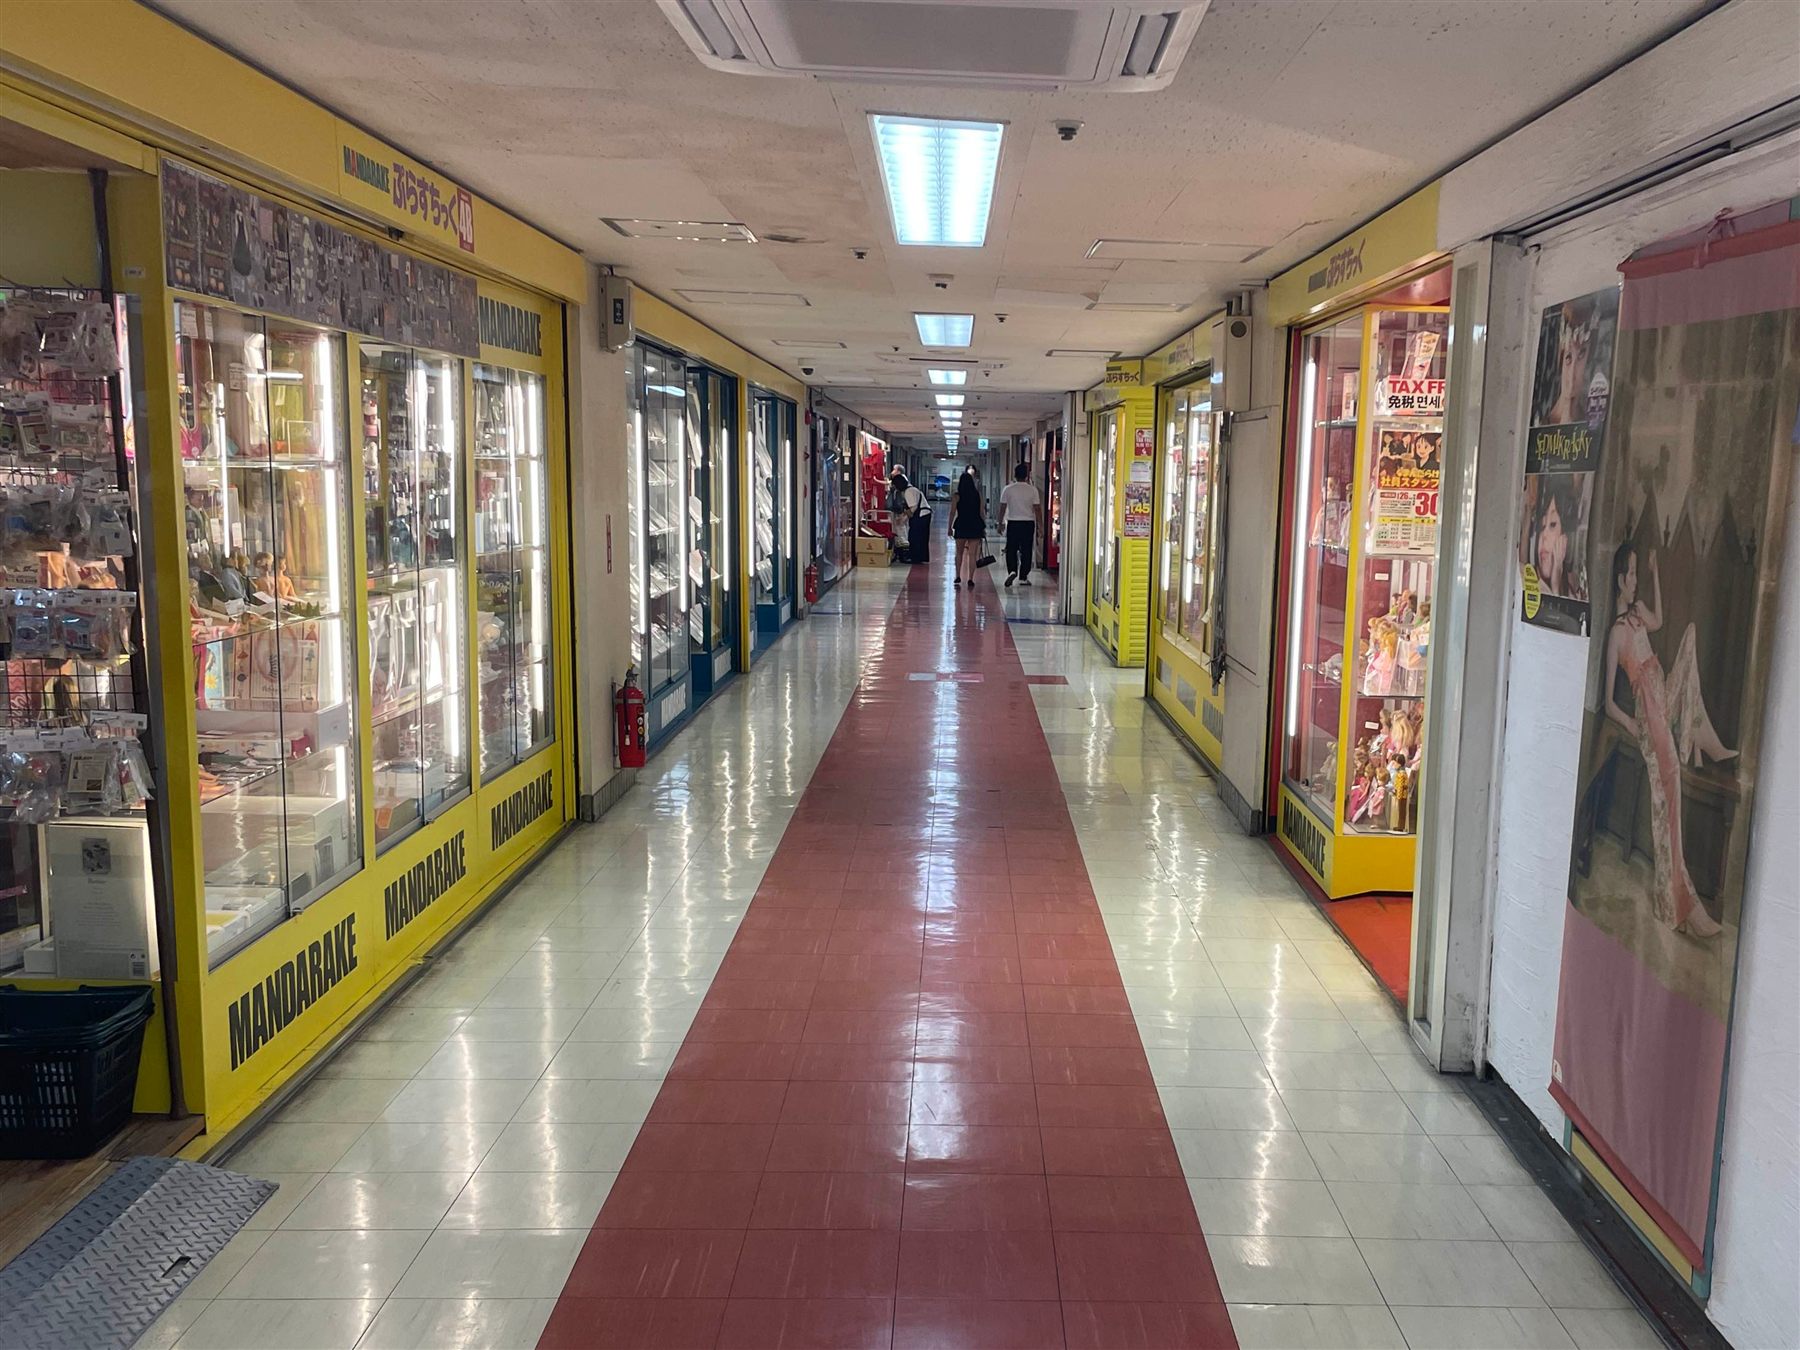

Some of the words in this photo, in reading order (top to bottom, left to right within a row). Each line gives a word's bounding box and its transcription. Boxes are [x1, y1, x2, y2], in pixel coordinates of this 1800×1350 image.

[343, 145, 390, 194] MANDARAKE
[392, 162, 458, 236] ぷらすちっく
[479, 295, 542, 357] MANDARAKE
[1388, 380, 1424, 394] TAX
[1388, 395, 1415, 408] 免税
[1417, 395, 1440, 408] 면세
[491, 768, 554, 852] MANDARAKE
[384, 829, 466, 942] MANDARAKE
[228, 912, 358, 1072] MANDARAKE
